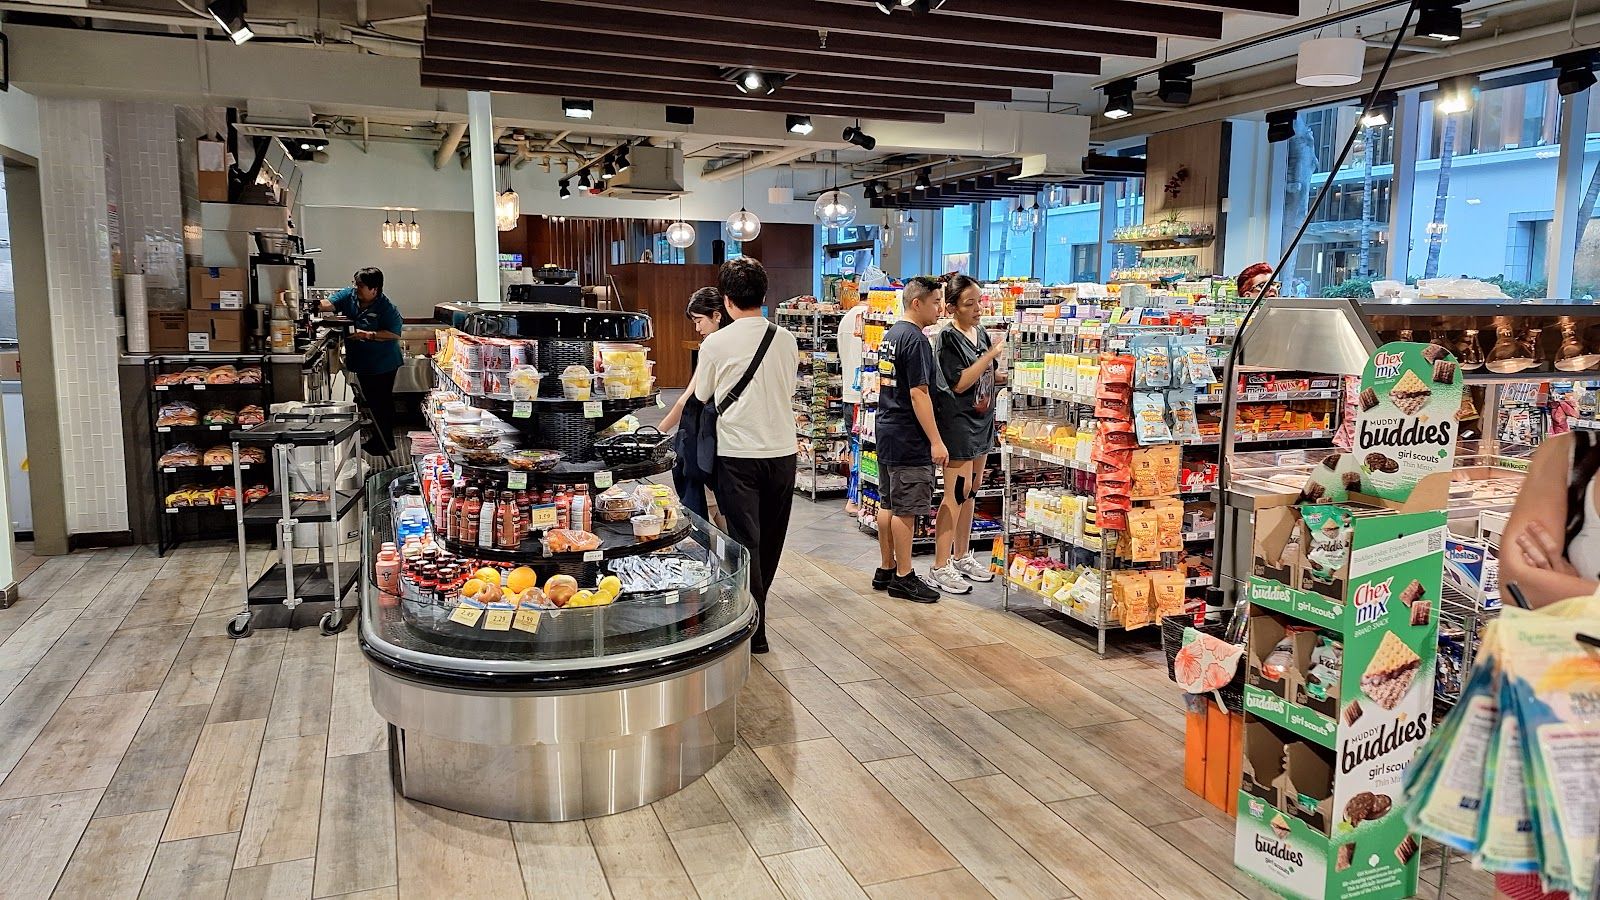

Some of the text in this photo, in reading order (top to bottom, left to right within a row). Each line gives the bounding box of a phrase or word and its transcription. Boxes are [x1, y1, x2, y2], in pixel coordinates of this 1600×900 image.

[1374, 351, 1404, 366] Chex
[1375, 366, 1400, 378] mix
[1370, 418, 1398, 426] MUDDY
[1360, 417, 1451, 449] buddies
[1398, 450, 1439, 463] girl scouts
[1450, 549, 1479, 561] Hostess
[1354, 577, 1393, 607] Chex
[1252, 584, 1335, 619] buddies girl scouts
[1357, 602, 1388, 625] mix
[1246, 692, 1328, 736] buddies girl scouts
[1342, 713, 1427, 774] buddies
[1351, 726, 1379, 744] MUDDY
[1369, 764, 1385, 780] girl
[1376, 779, 1389, 787] Thin
[1255, 833, 1303, 867] buddies
